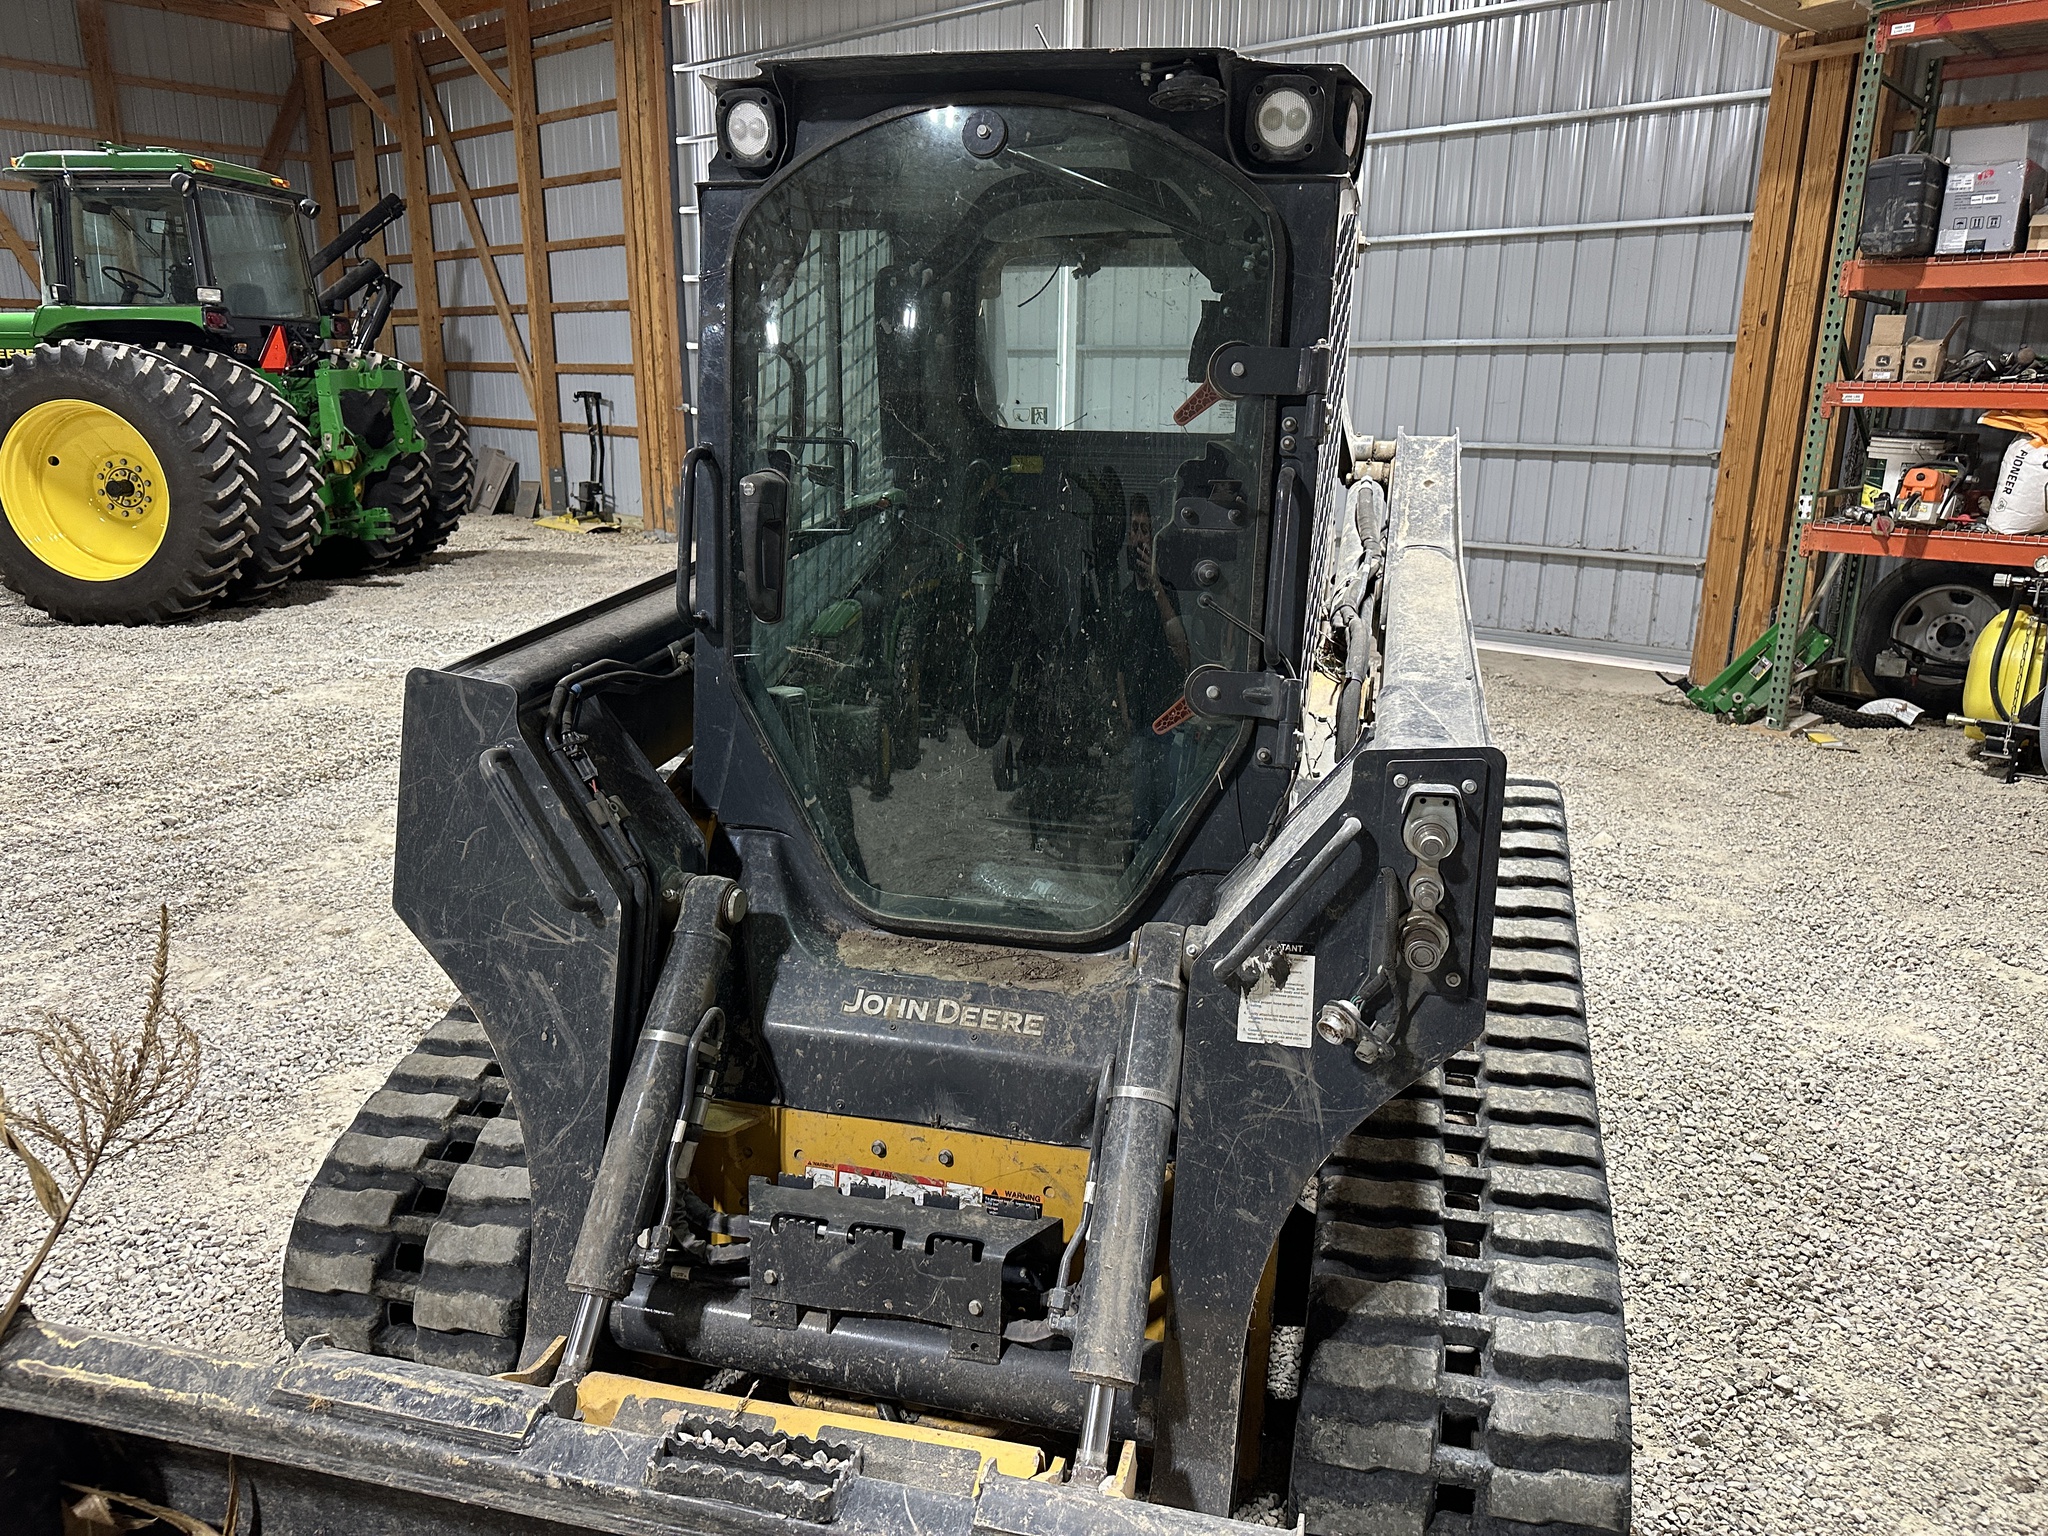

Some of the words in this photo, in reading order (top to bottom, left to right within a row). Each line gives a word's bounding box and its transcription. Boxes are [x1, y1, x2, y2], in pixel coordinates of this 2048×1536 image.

[2003, 449, 2029, 495] PIONEER
[843, 988, 929, 1022] JOHN
[934, 998, 1044, 1036] DEERE
[1004, 1190, 1041, 1203] WARNING
